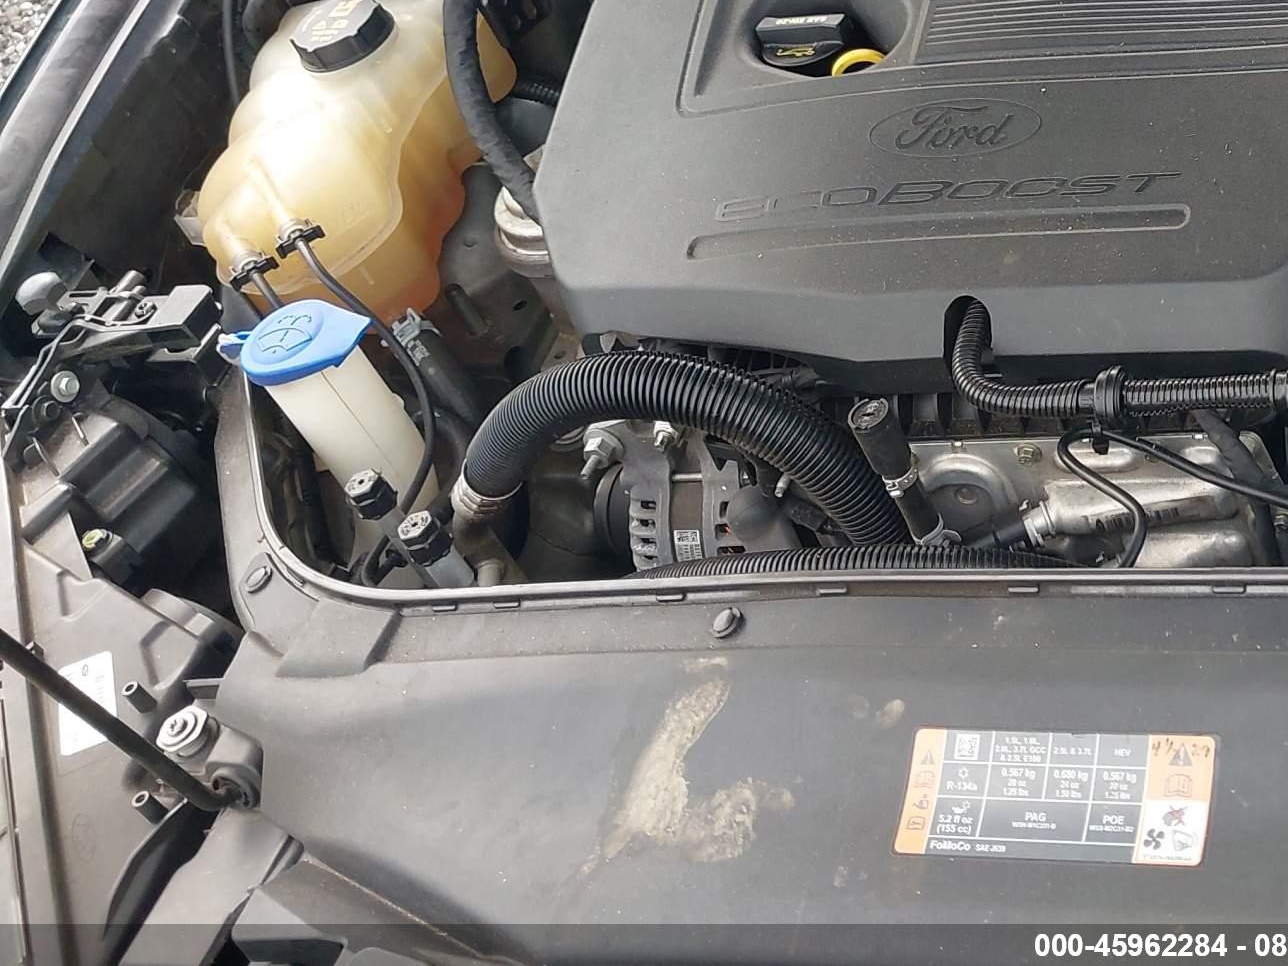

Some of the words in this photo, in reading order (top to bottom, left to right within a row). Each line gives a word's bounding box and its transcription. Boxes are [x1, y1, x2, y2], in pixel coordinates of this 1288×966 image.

[895, 105, 1015, 150] Ford
[946, 781, 978, 791] R-134a
[1024, 812, 1047, 822] PAG
[1102, 815, 1126, 825] POE
[936, 824, 956, 834] (155
[956, 825, 972, 835] cc)
[929, 840, 972, 851] FoMoCo
